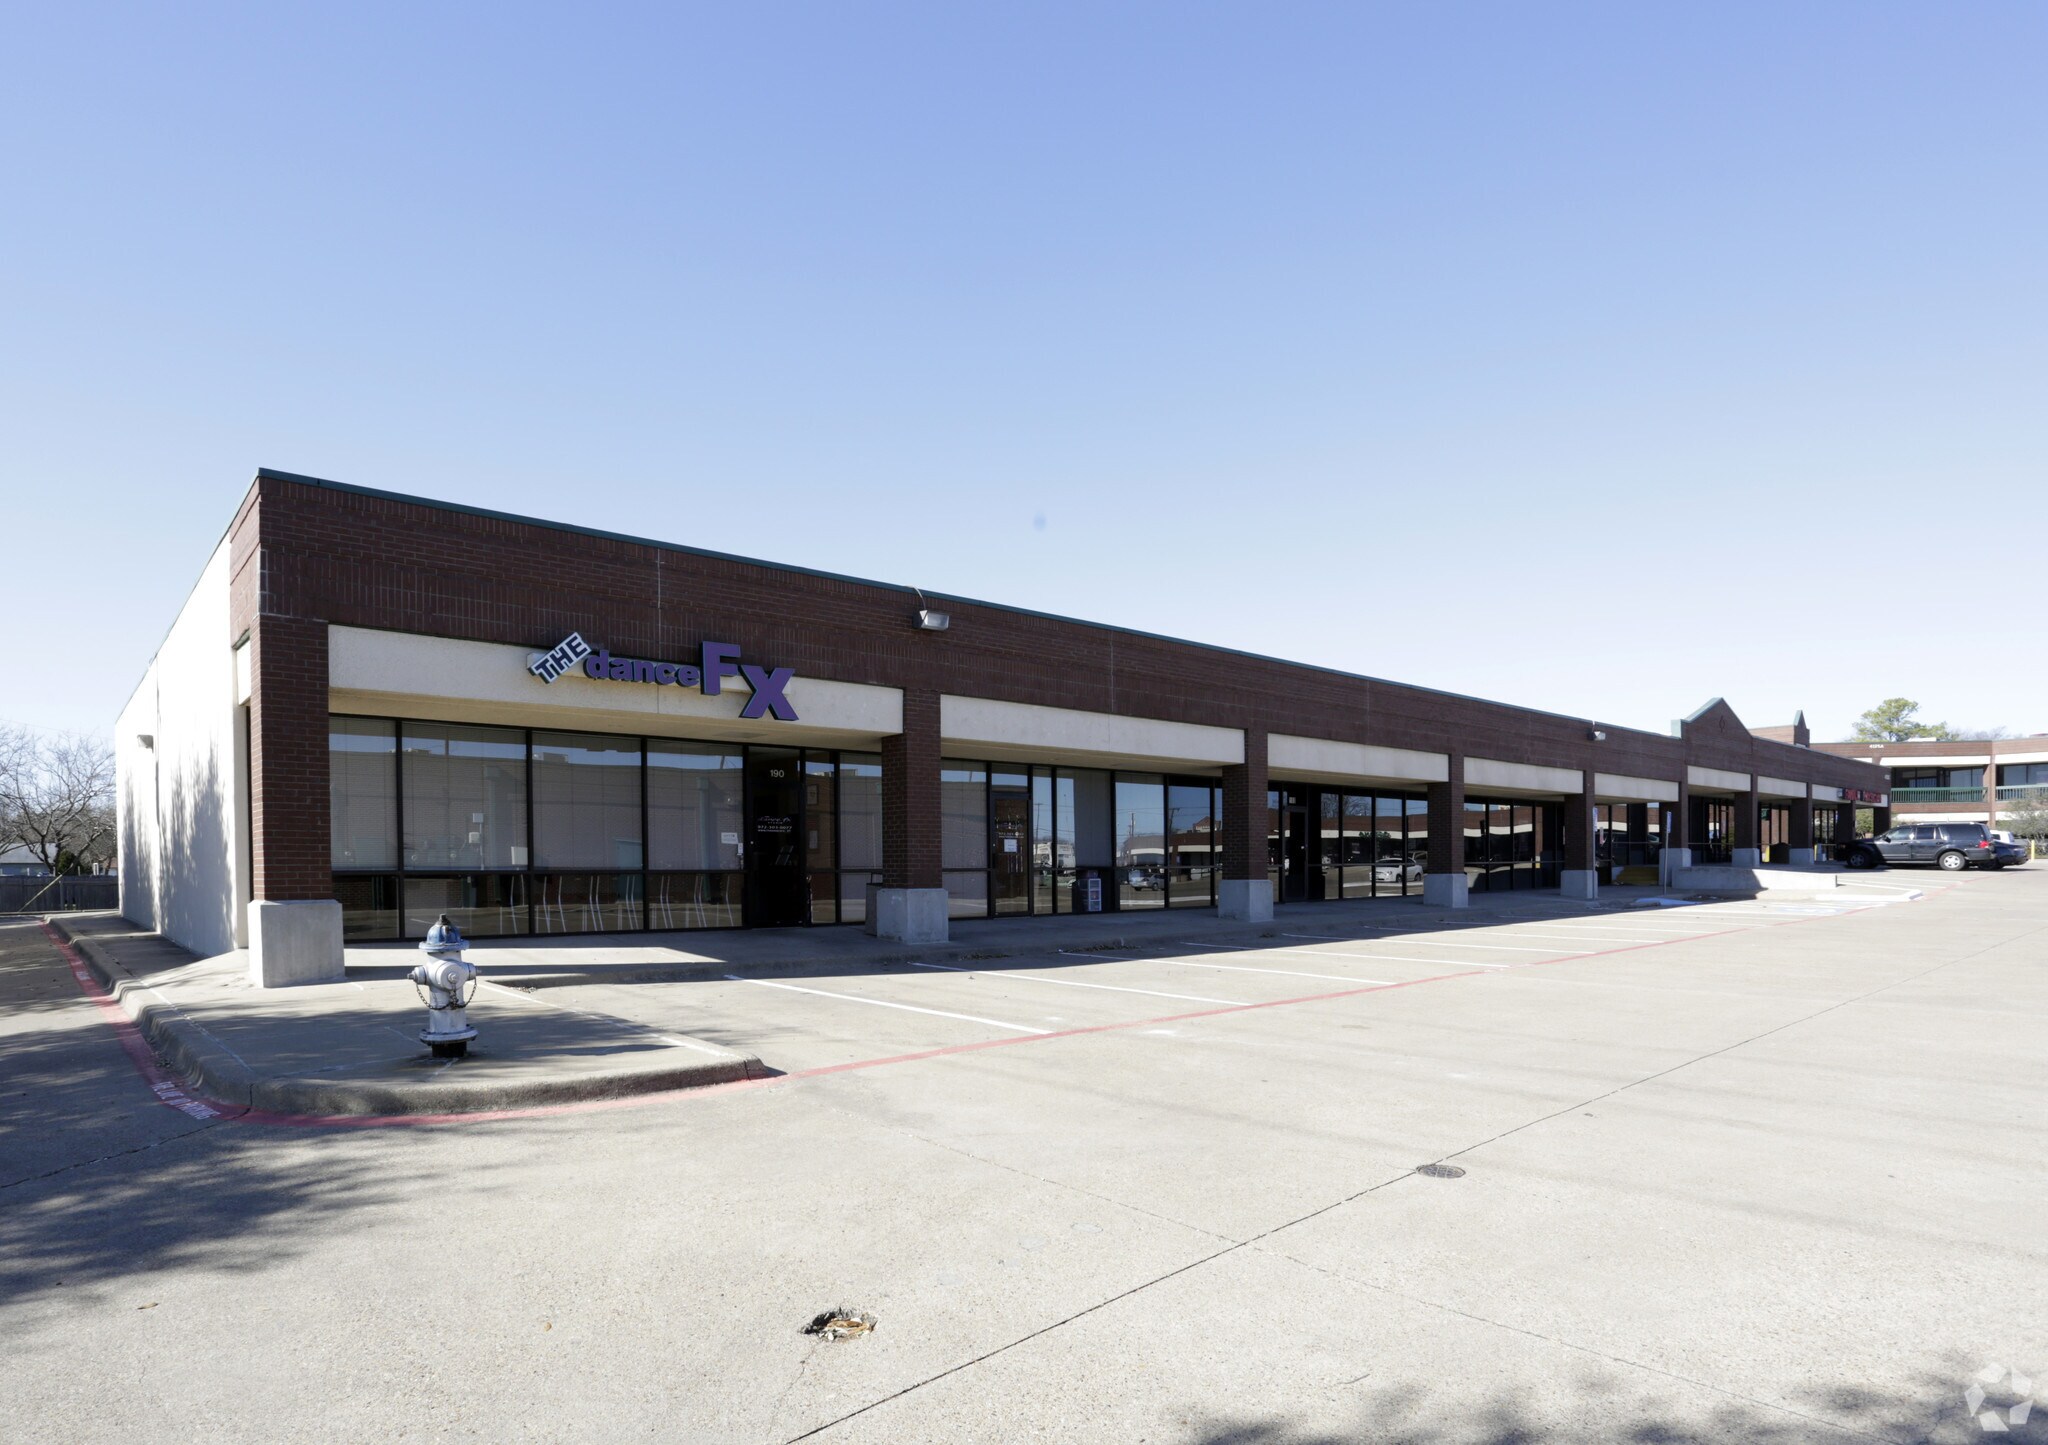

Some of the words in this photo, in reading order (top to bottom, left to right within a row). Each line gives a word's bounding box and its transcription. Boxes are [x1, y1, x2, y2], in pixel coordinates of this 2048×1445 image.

[532, 633, 591, 683] THE
[583, 650, 700, 687] dance
[770, 769, 784, 778] 190
